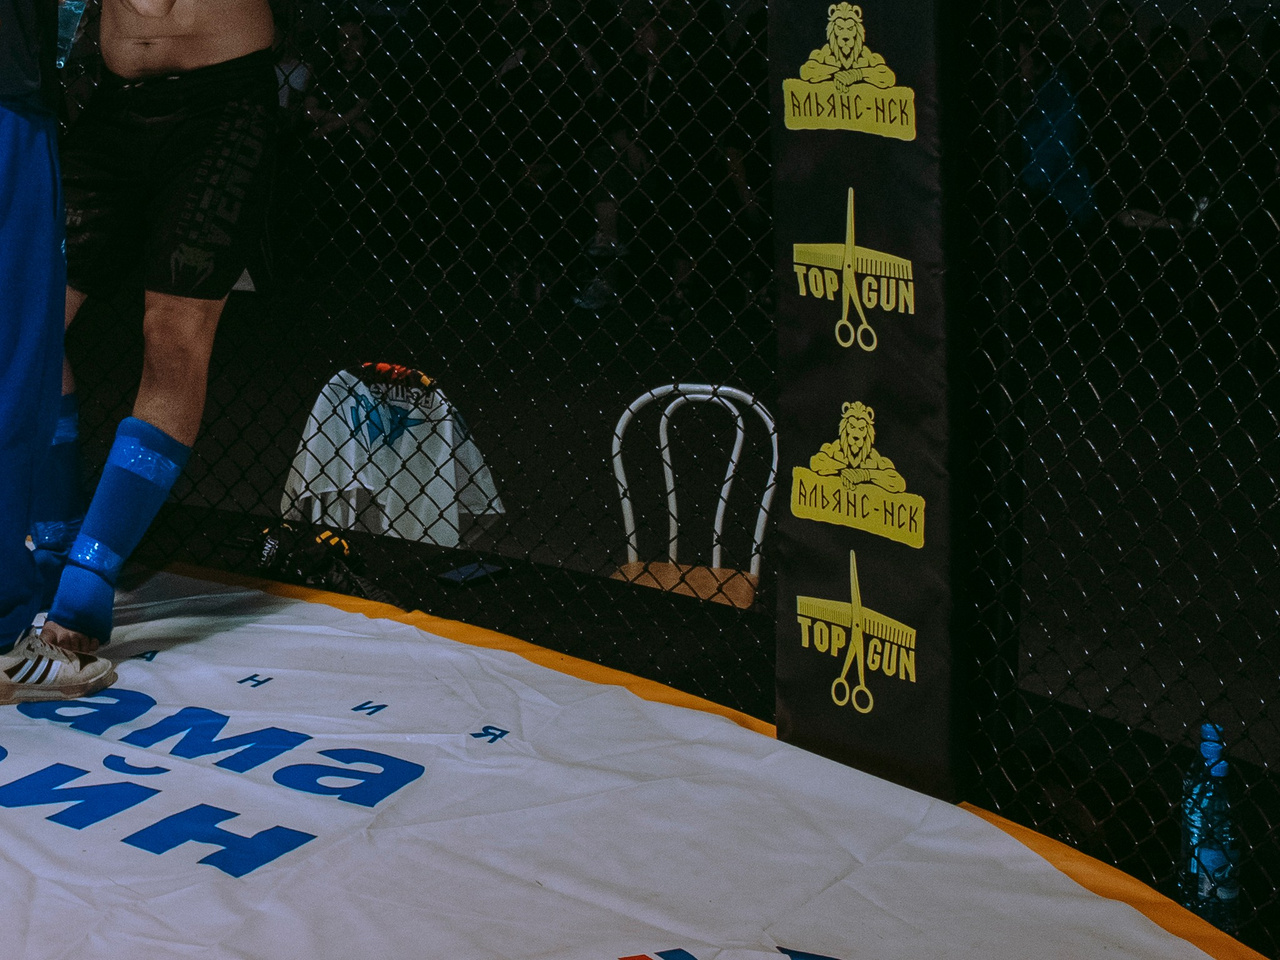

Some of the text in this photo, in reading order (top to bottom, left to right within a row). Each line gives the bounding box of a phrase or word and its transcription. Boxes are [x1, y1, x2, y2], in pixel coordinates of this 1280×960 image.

[790, 90, 909, 126] АЛЬЯНС-НСК
[793, 264, 915, 315] TOP GUN
[798, 478, 918, 533] АЛЬЯНС-НСК
[797, 615, 916, 683] TOP GUN
